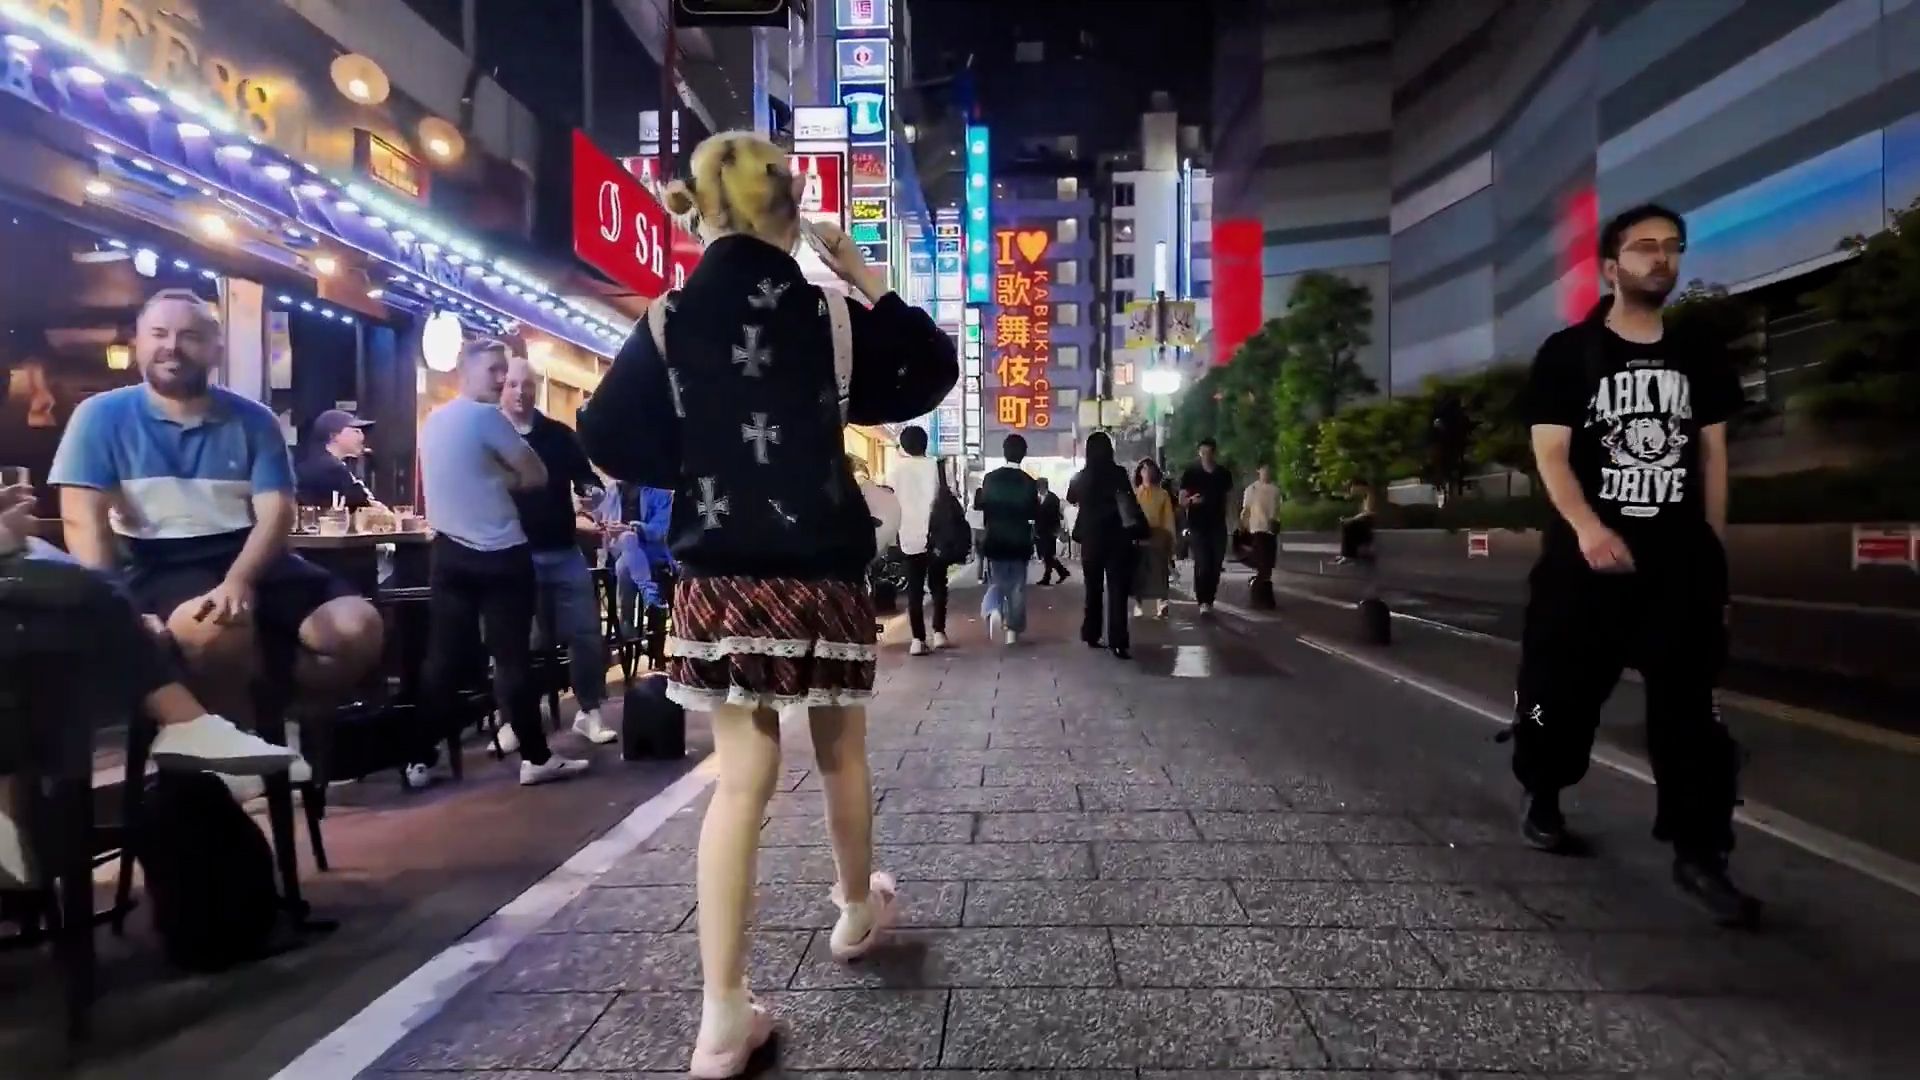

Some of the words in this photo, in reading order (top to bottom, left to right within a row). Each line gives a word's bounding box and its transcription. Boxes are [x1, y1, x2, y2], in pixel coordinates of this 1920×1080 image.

[996, 231, 1015, 265] I
[997, 272, 1031, 428] 歌舞伎町
[1033, 270, 1049, 427] KABUKI-CHO
[1598, 467, 1687, 503] DRIVE
